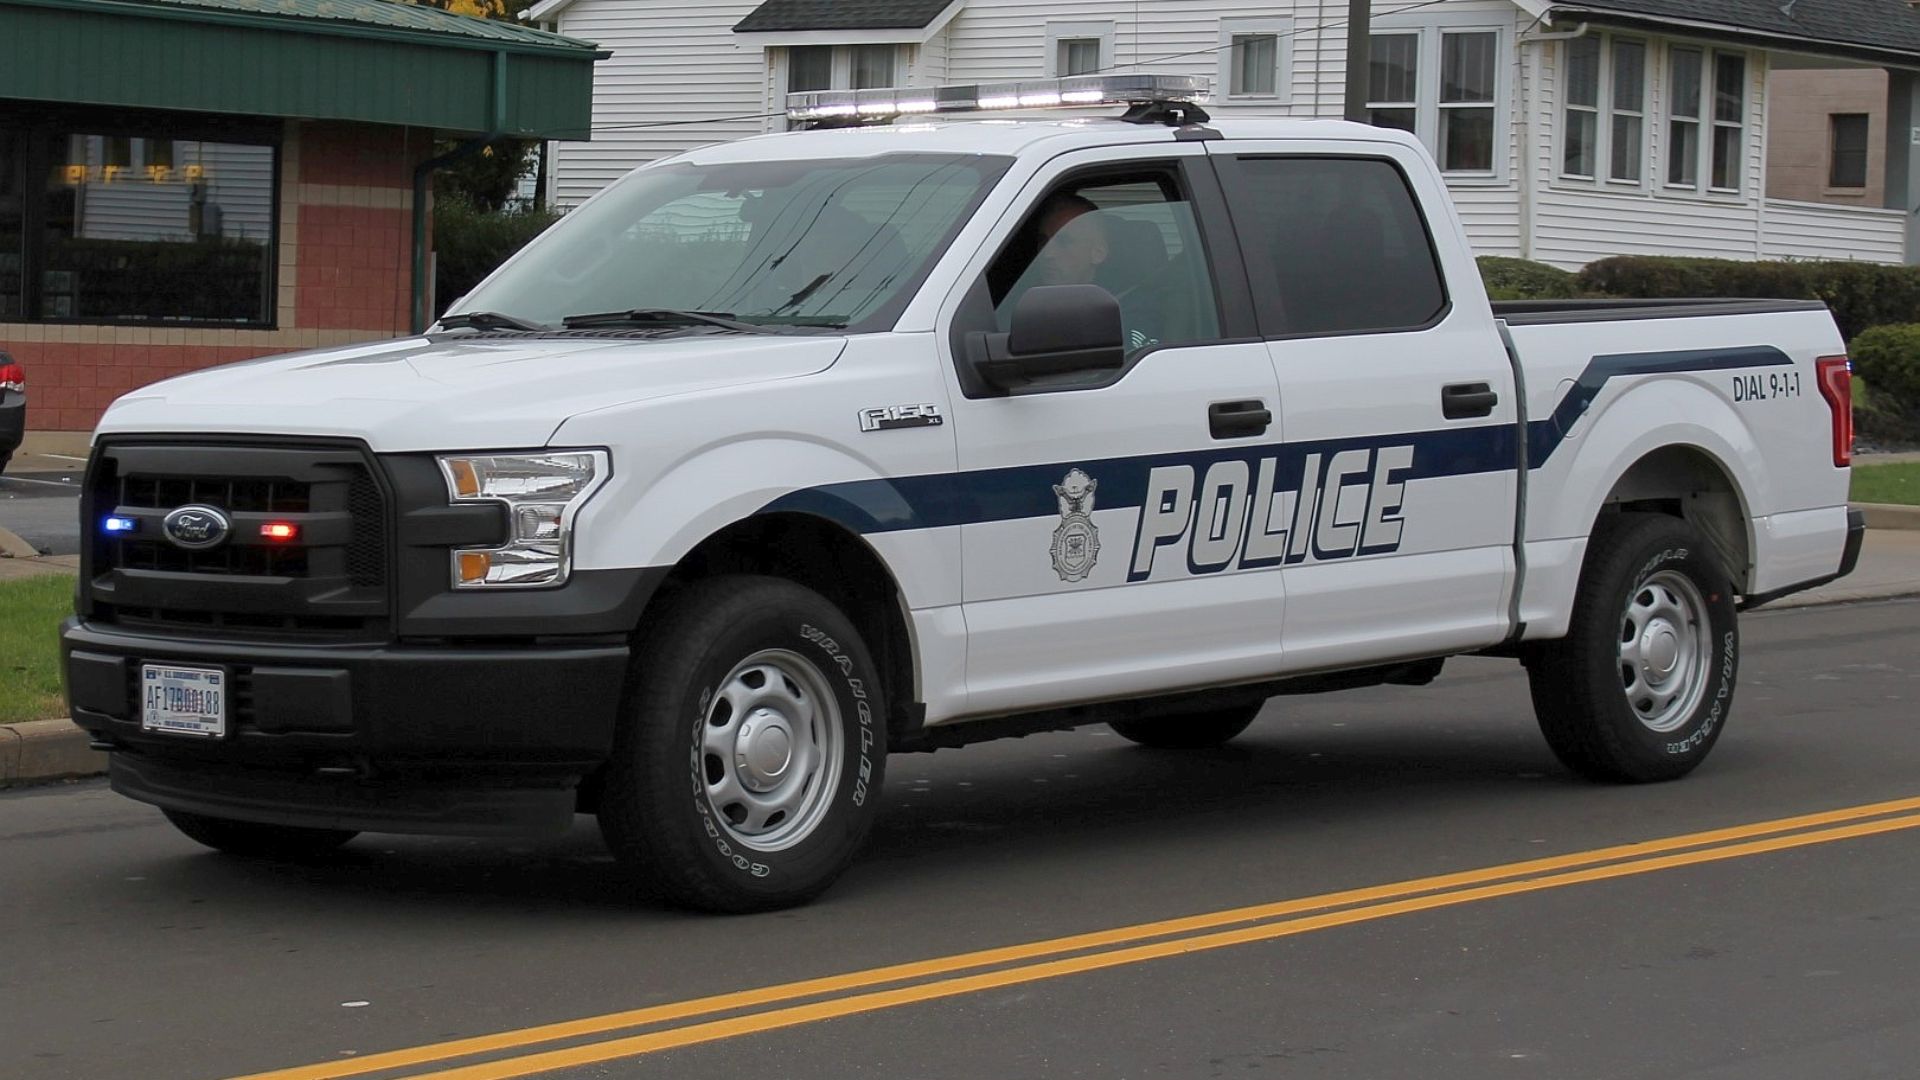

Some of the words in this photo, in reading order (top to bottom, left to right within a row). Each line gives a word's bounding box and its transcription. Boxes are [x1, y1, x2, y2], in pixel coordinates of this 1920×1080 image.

[1733, 375, 1766, 402] DIAL
[1770, 372, 1800, 399] 9-1-1
[175, 514, 211, 539] Ford
[1127, 445, 1414, 582] POLICE
[146, 685, 219, 715] AF17B00188
[801, 624, 873, 807] WRANGLER
[1667, 631, 1735, 754] WRANGLER
